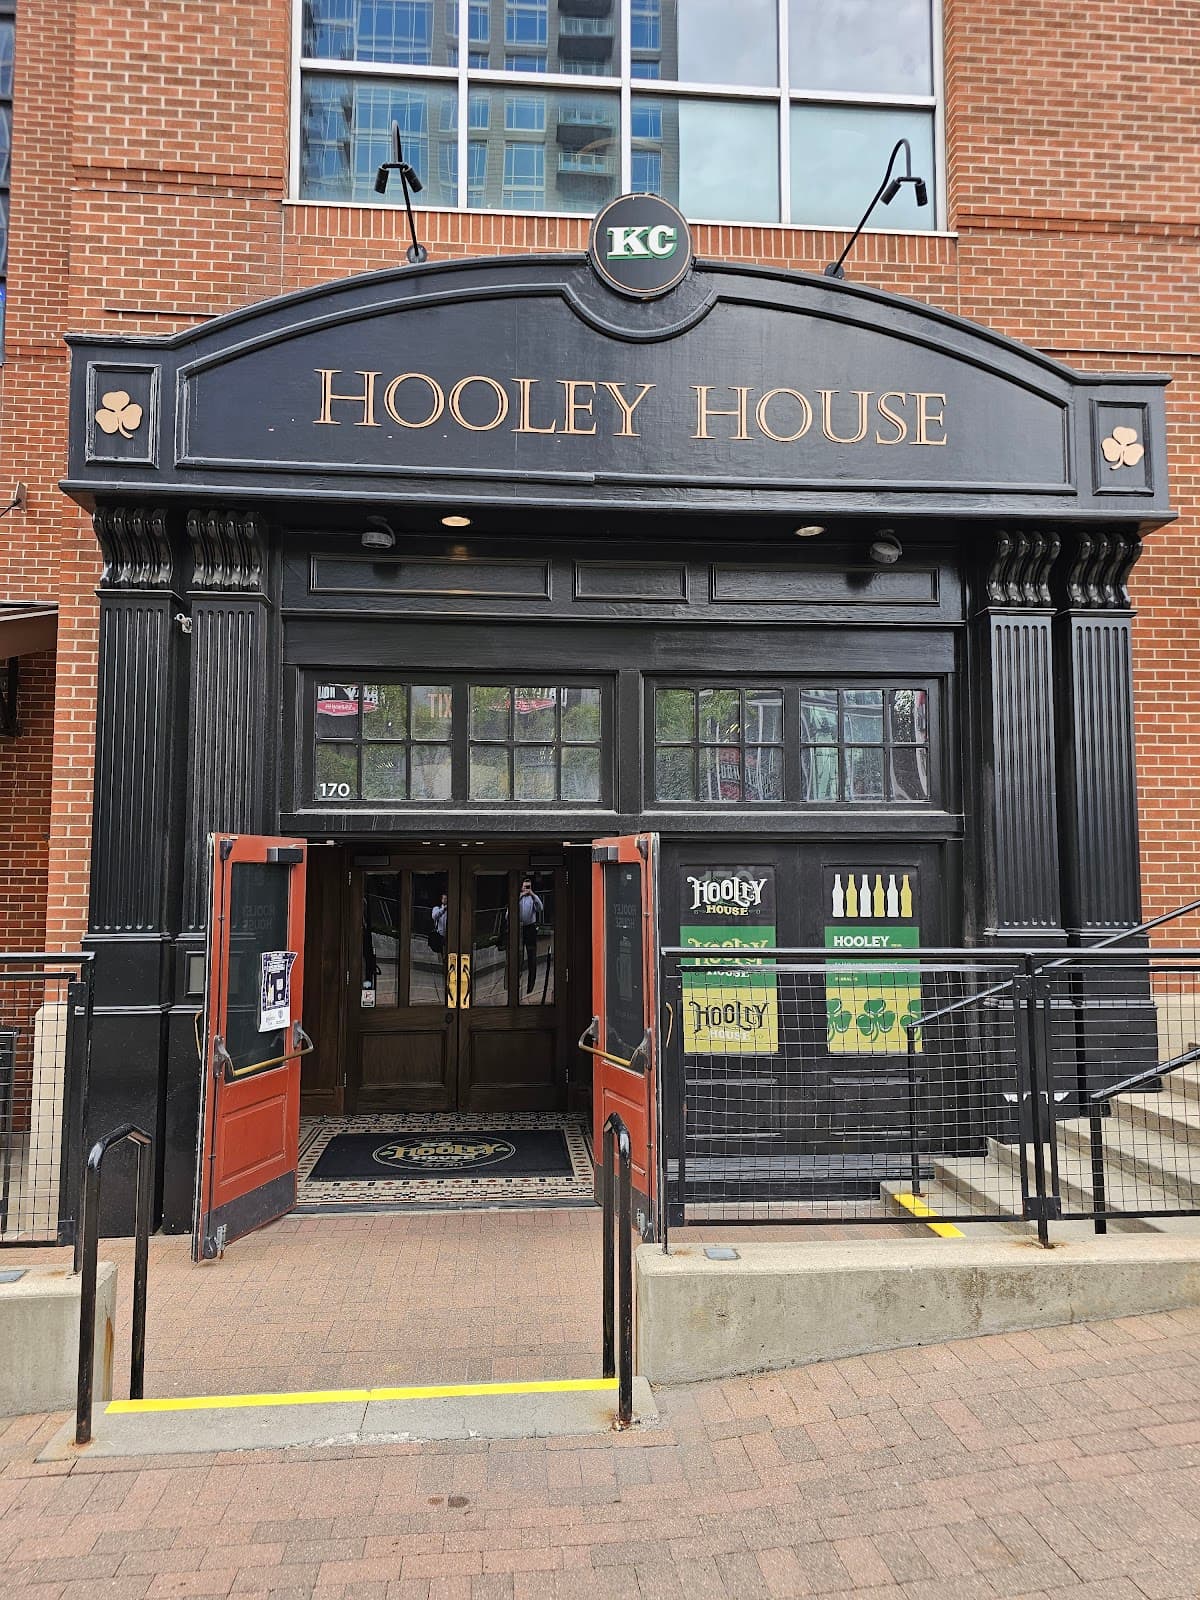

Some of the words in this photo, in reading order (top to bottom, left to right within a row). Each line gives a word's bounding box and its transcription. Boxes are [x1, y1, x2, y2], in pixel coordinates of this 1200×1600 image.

[607, 224, 678, 260] KC
[312, 368, 658, 438] HOOLEY
[690, 385, 948, 447] HOUSE
[319, 782, 351, 798] 170
[687, 876, 768, 910] HOOLEY
[706, 904, 749, 916] HOUSE
[833, 935, 890, 948] HOOLEY
[689, 1000, 770, 1035] HOOLEY
[708, 1029, 750, 1040] HOUSE
